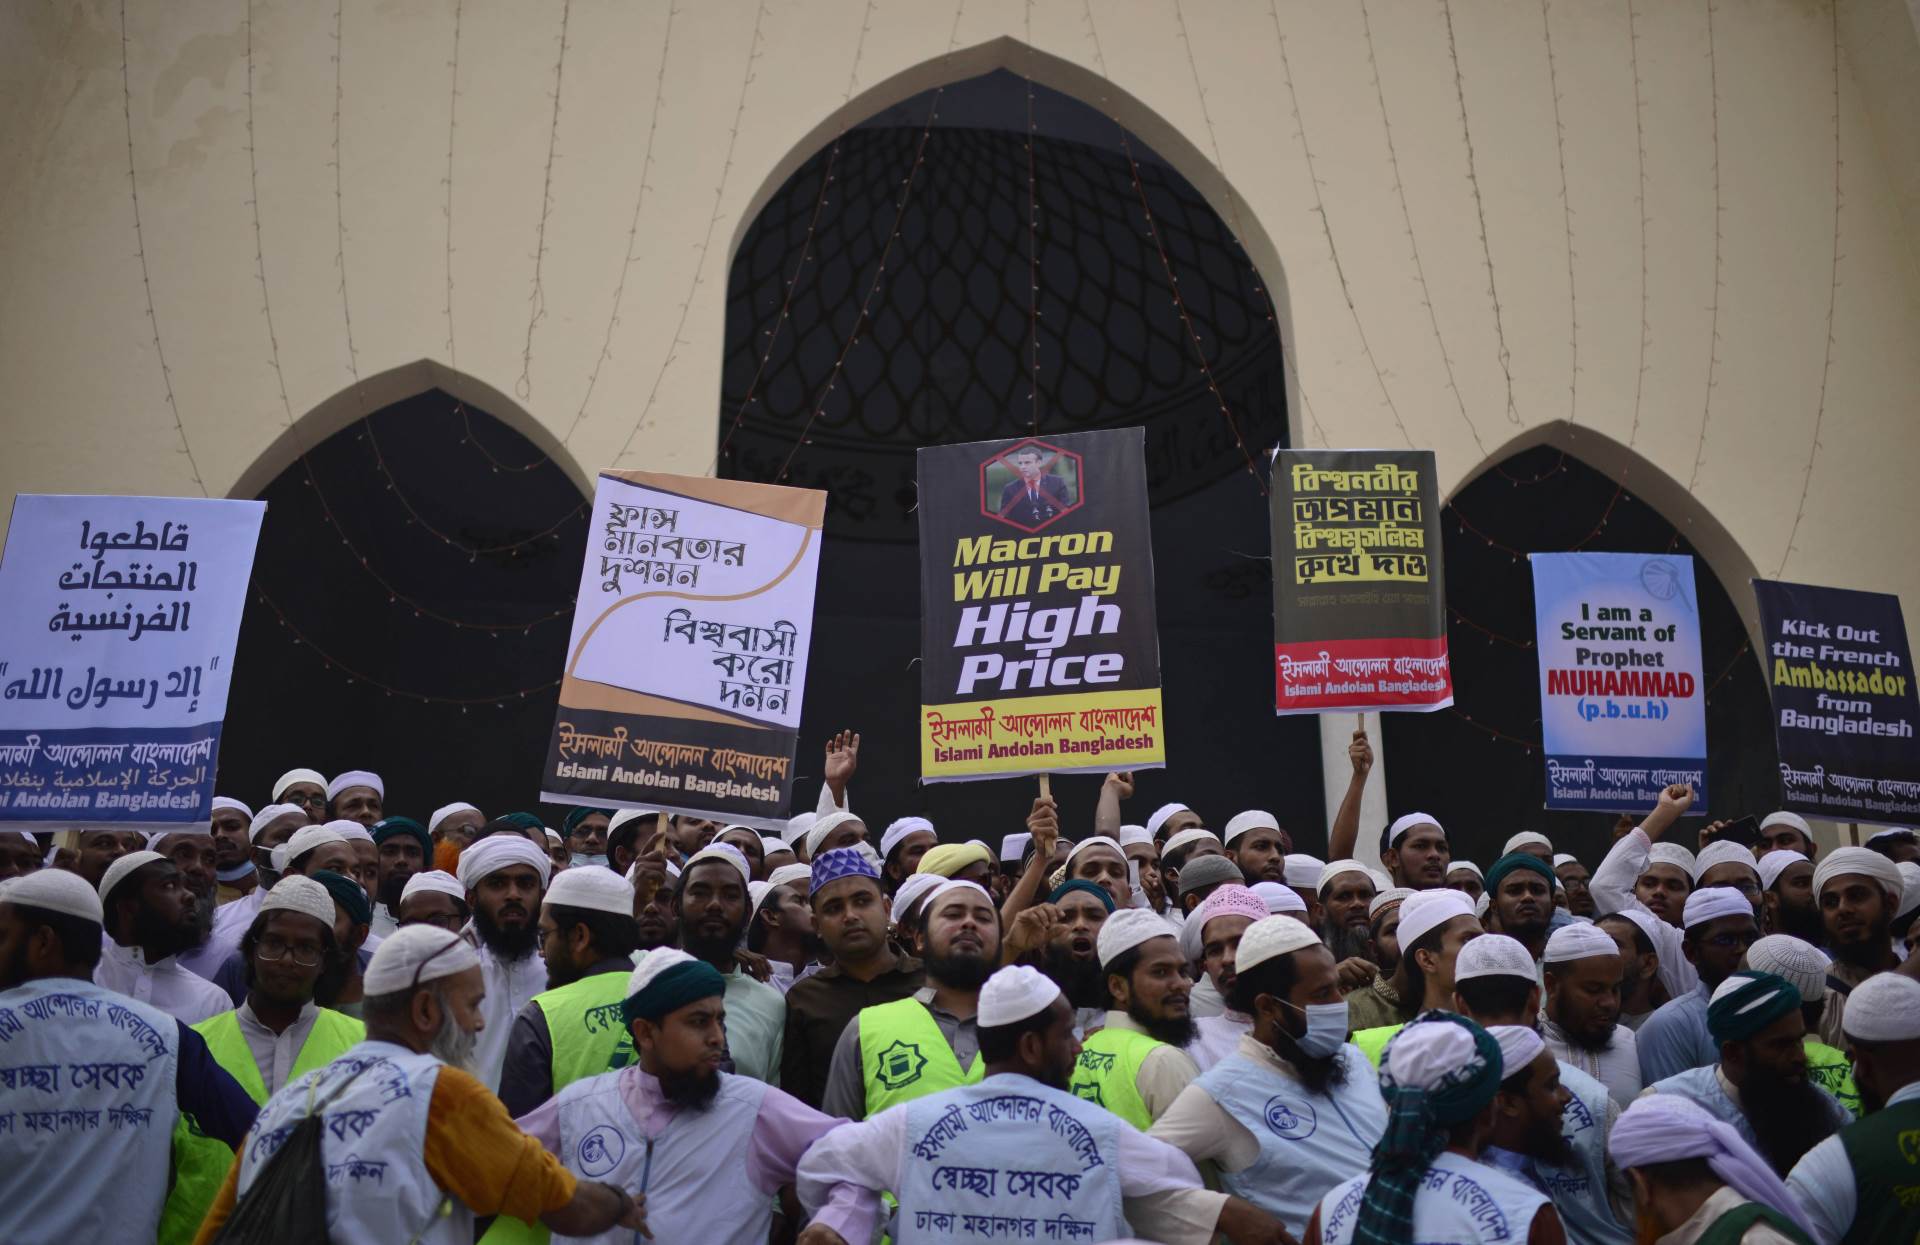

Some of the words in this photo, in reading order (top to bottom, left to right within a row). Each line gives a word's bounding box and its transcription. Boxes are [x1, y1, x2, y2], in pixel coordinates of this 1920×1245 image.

[80, 520, 189, 559] قاطعوا
[605, 531, 747, 566] মানবতার
[953, 531, 1114, 567] Macron
[59, 559, 197, 600] المنتجات
[600, 556, 701, 595] দুশমন
[953, 566, 1030, 601] Will
[1038, 562, 1121, 596] Pay
[49, 601, 191, 642] الفرنسية
[953, 595, 1122, 651] High
[1581, 603, 1589, 620] I
[1597, 607, 1632, 621] am
[1639, 608, 1653, 622] a
[664, 608, 798, 657] বিশ্ববাসী
[1561, 622, 1647, 641] Servant
[1654, 624, 1676, 642] of
[1781, 619, 1831, 639] Kick
[1836, 625, 1880, 643] Out
[712, 650, 794, 685] করো
[1279, 651, 1331, 682] ইসলামী
[1333, 658, 1392, 678] আন্দোলন
[1576, 647, 1665, 670] Prophet
[1772, 641, 1815, 659] the
[1819, 645, 1900, 667] French
[956, 649, 1123, 695] Price
[1285, 684, 1321, 697] Islami
[1325, 681, 1375, 694] Andolan
[1378, 678, 1447, 694] Bangladesh
[1547, 669, 1695, 698] MUHAMMAD
[1774, 658, 1906, 696] Ambassador
[66, 667, 158, 710] رسول
[719, 680, 791, 714] দমন
[1816, 693, 1872, 714] from
[1577, 698, 1669, 721] (p.b.u.h)
[1780, 708, 1912, 738] Bangladesh
[927, 706, 996, 747] ইসলামী
[999, 712, 1076, 738] আন্দোলন
[1079, 705, 1157, 736] বাংলাদেশ
[43, 743, 129, 768] আন্দোলন
[131, 737, 215, 769] বাংলাদেশ
[558, 722, 628, 760] ইসলামী
[631, 738, 709, 768] আন্দোলন
[710, 748, 790, 781] বাংলাদেশ
[934, 744, 983, 763] Islami
[988, 740, 1054, 760] Andolan
[1059, 733, 1154, 756] Bangladesh
[53, 768, 140, 793] الإسلامية
[147, 766, 206, 791] الحركة
[556, 762, 608, 781] Islami
[611, 766, 680, 789] Andolan
[684, 775, 780, 802] Bangladesh
[1547, 759, 1595, 787] ইসলামী
[1597, 767, 1649, 787] আন্দোলন
[1650, 769, 1703, 787] বাংলাদেশ
[1779, 762, 1825, 789] ইসলামী
[1827, 773, 1875, 794] আন্দোলন
[12, 790, 90, 808] Andolan
[95, 790, 200, 812] Bangladesh
[1553, 787, 1587, 800] Islami
[1589, 788, 1634, 801] Andolan
[1786, 790, 1818, 803] Islami
[1821, 793, 1862, 808] Andolan
[18, 993, 102, 1020] আন্দোলন
[107, 1002, 169, 1061] বাংলাদেশ
[69, 1063, 146, 1090] সেবক
[23, 1108, 102, 1133] মহানগর
[966, 1095, 1046, 1123] আন্দোলন
[1049, 1104, 1105, 1171] বাংলাদেশ
[1006, 1170, 1082, 1200] সেবক
[915, 1210, 957, 1234] ঢাকা
[962, 1214, 1037, 1238] মহানগর
